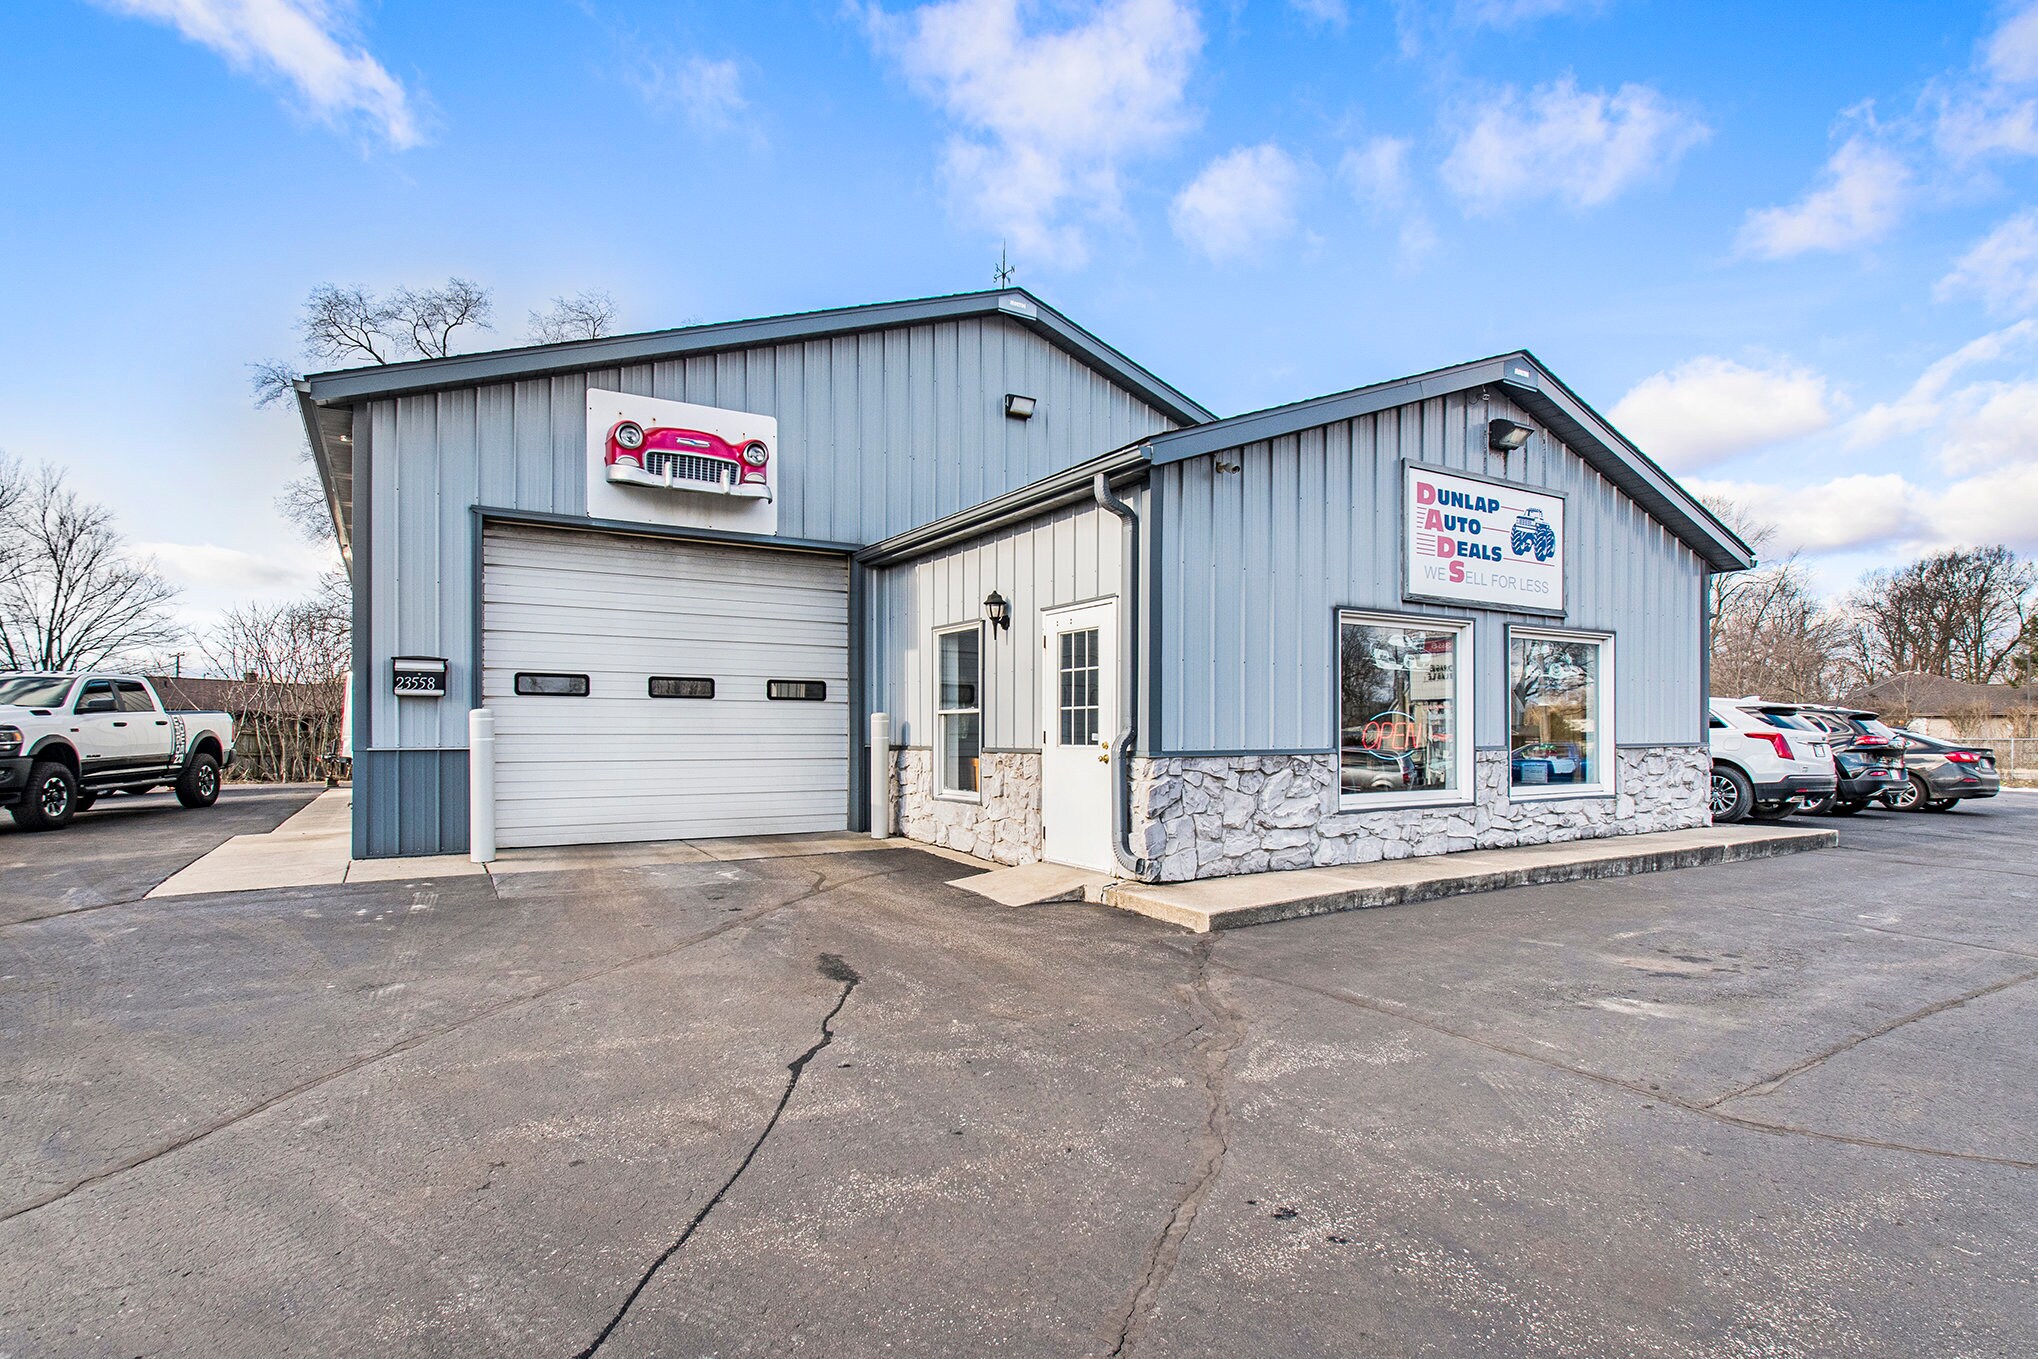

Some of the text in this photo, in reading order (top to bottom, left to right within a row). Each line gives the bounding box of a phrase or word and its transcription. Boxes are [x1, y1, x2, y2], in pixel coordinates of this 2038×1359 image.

[1416, 481, 1500, 514] DUNLAP
[1424, 508, 1481, 535] AUTO
[1436, 535, 1502, 562] DEALS
[1424, 560, 1549, 594] WE SELL FOR LESS
[395, 676, 436, 690] 23558
[1362, 721, 1422, 750] OPEN
